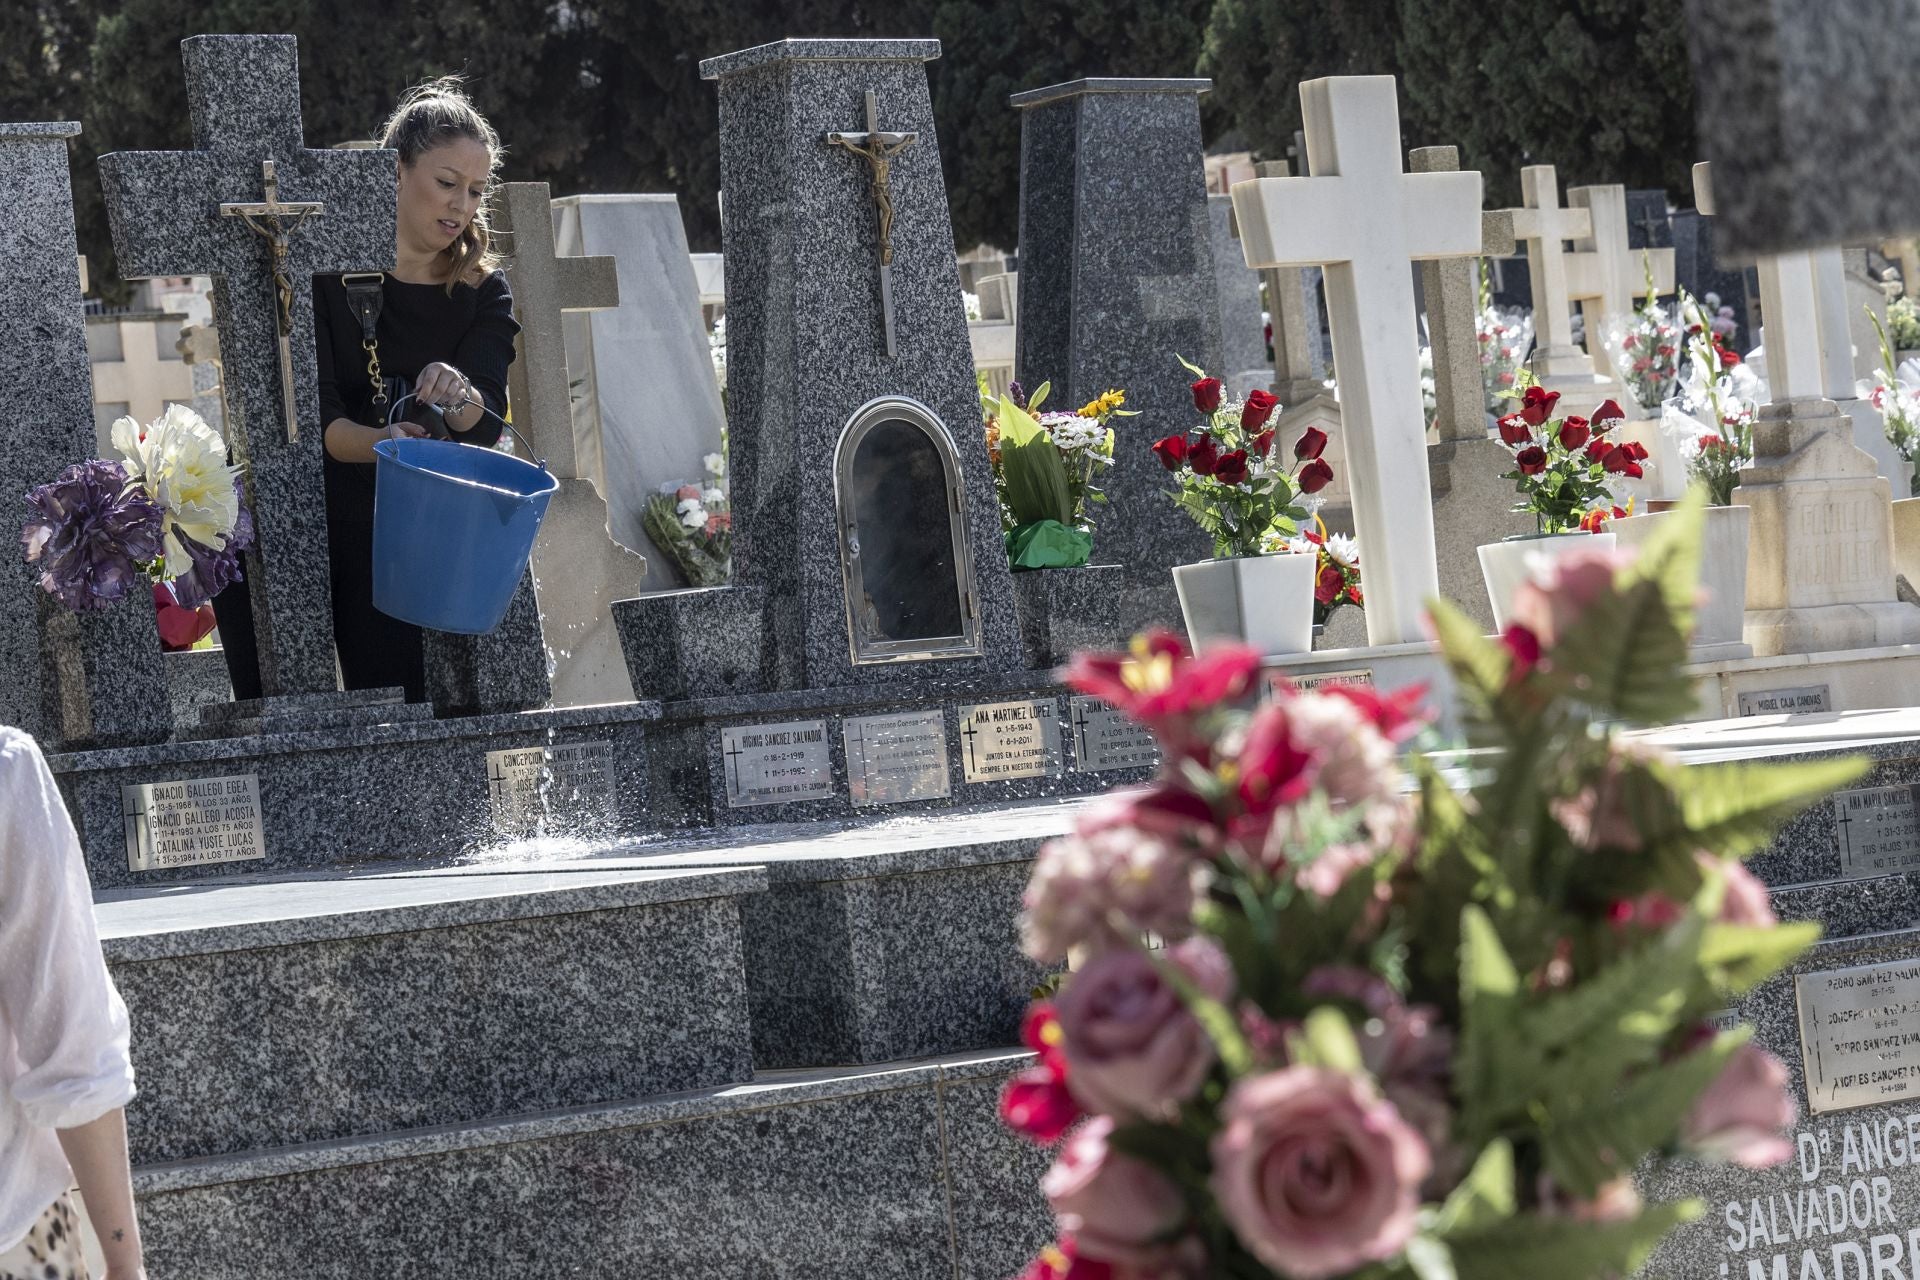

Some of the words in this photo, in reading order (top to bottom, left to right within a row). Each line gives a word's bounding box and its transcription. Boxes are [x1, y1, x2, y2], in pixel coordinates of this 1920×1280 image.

[1289, 681, 1302, 690] UAN
[1305, 678, 1337, 689] MARTINEZ
[1341, 675, 1367, 686] BENITEZ
[1086, 701, 1101, 713] JUAN
[1781, 698, 1795, 708] CAJA
[976, 711, 990, 724] ANA
[993, 707, 1026, 722] MARTINEZ
[1030, 705, 1051, 718] LOPEZ
[765, 732, 790, 746] SANCHEZ
[793, 729, 822, 744] SALVADOR
[504, 751, 544, 768] CONCEPCION
[581, 745, 610, 759] CANOVAS
[986, 752, 1004, 761] JUNTOS
[980, 766, 1000, 774] SIEMPRE
[1012, 763, 1032, 771] NUESTRO
[152, 786, 184, 801] IGNACIO
[187, 781, 223, 798] GALLEGO
[227, 780, 248, 794] EGEA
[195, 800, 199, 808] A
[202, 798, 217, 808] LOS
[220, 797, 228, 805] 33
[231, 795, 251, 805] AÑOS
[1850, 795, 1861, 810] ANA
[1863, 793, 1882, 808] MARIA
[1884, 790, 1910, 806] SANCHEZ
[149, 813, 181, 828] IGNACIO
[185, 810, 221, 825] GALLEGO
[225, 806, 255, 820] ACOSTA
[204, 824, 219, 833] LOS
[233, 821, 254, 830] AÑOS
[156, 839, 195, 854] CATALINA
[199, 835, 223, 849] YUSTE
[227, 832, 254, 847] LUCAS
[1862, 844, 1876, 855] TUS
[1880, 841, 1901, 852] HIJOS
[1906, 840, 1910, 849] Y
[199, 852, 204, 860] A
[207, 850, 221, 859] LOS
[224, 849, 233, 857] 77
[236, 847, 257, 856] AÑOS
[1874, 858, 1884, 868] NO
[1888, 857, 1897, 866] TE
[1828, 977, 1854, 990] PEDRO
[1895, 967, 1920, 980] SALVA
[1828, 1009, 1876, 1025] CONCEPC
[1725, 1176, 1897, 1251] SALVADOR
